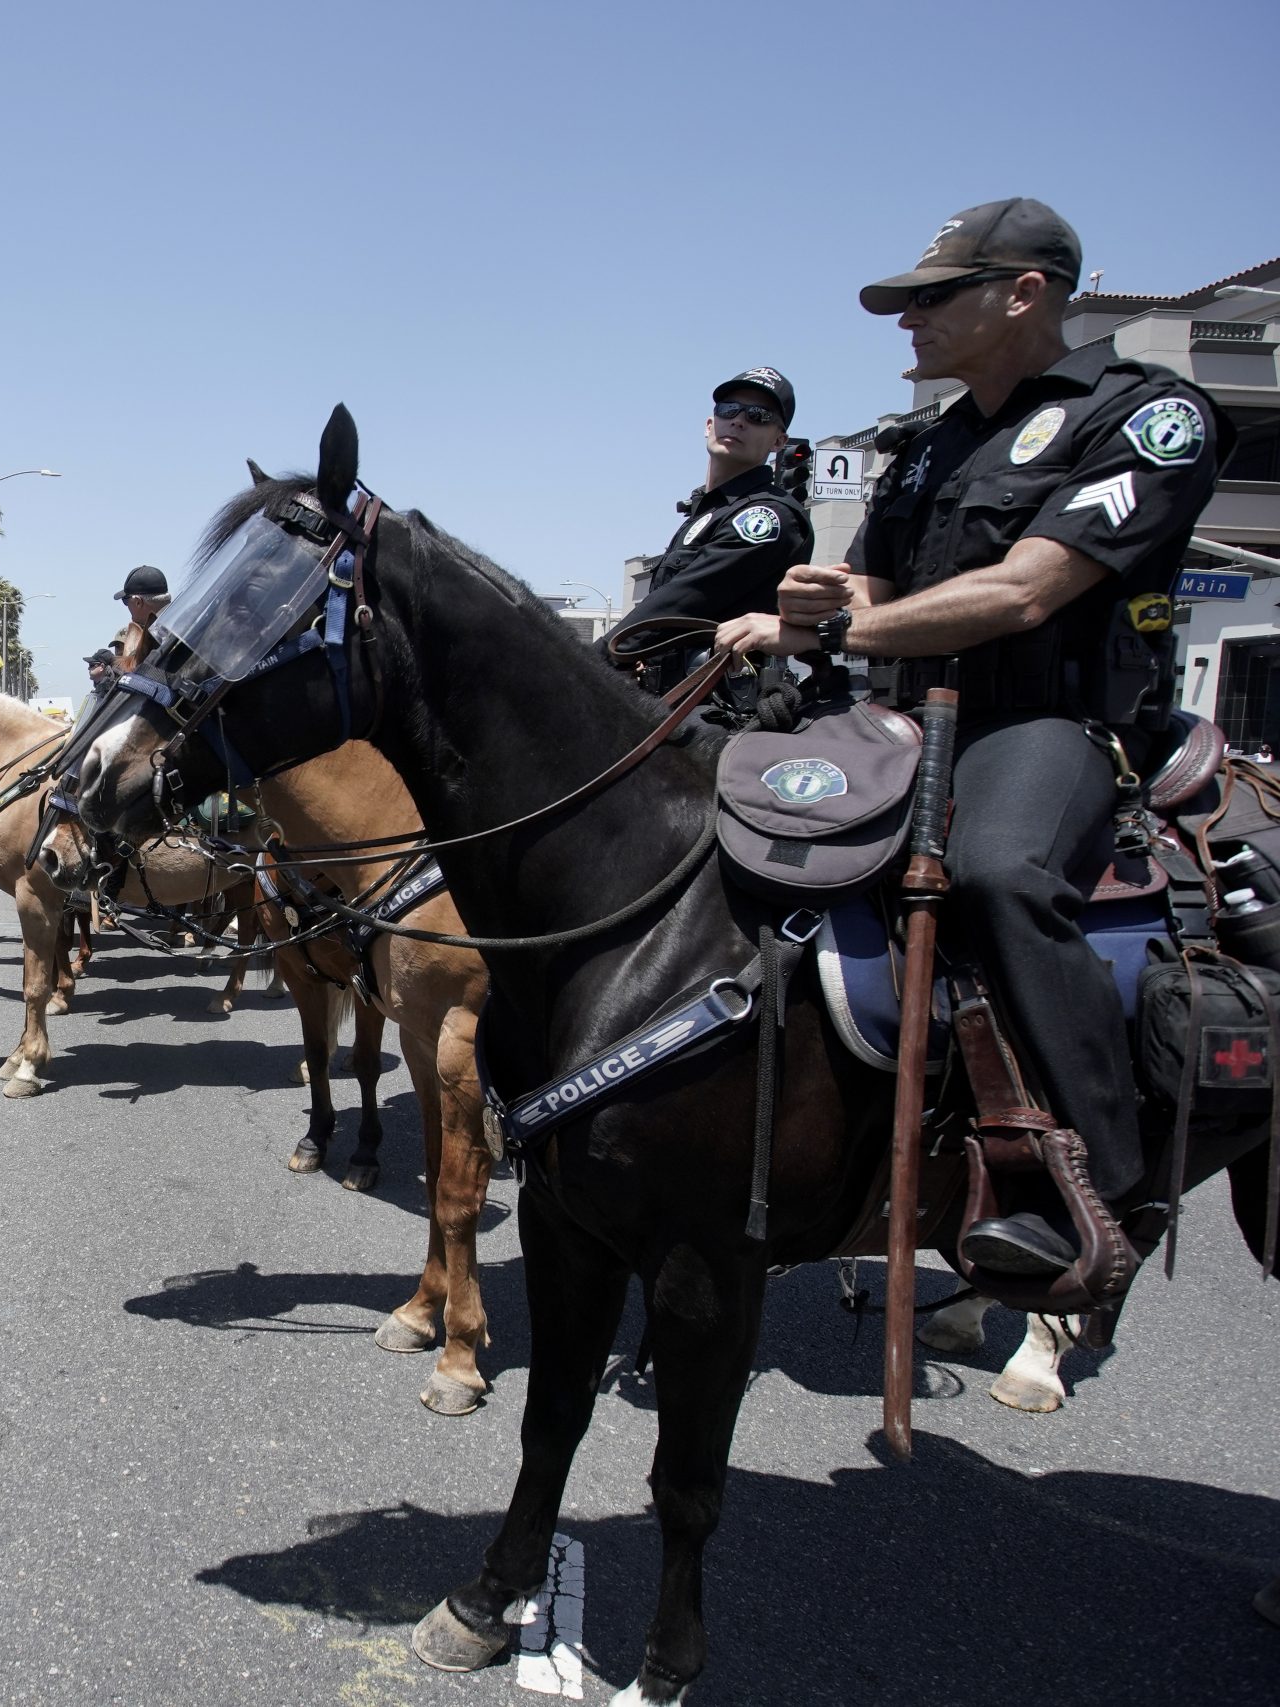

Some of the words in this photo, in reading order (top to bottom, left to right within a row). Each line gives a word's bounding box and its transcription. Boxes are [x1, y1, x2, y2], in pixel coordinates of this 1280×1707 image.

[1152, 402, 1202, 436] POLICE
[815, 485, 823, 495] U
[826, 487, 843, 495] TURN
[844, 488, 861, 496] ONLY
[747, 508, 779, 527] POLICE
[1180, 578, 1227, 593] Main
[1191, 656, 1209, 706] 7
[782, 761, 839, 778] POLICE
[371, 879, 425, 920] POLICE
[545, 1044, 647, 1112] POLICE
